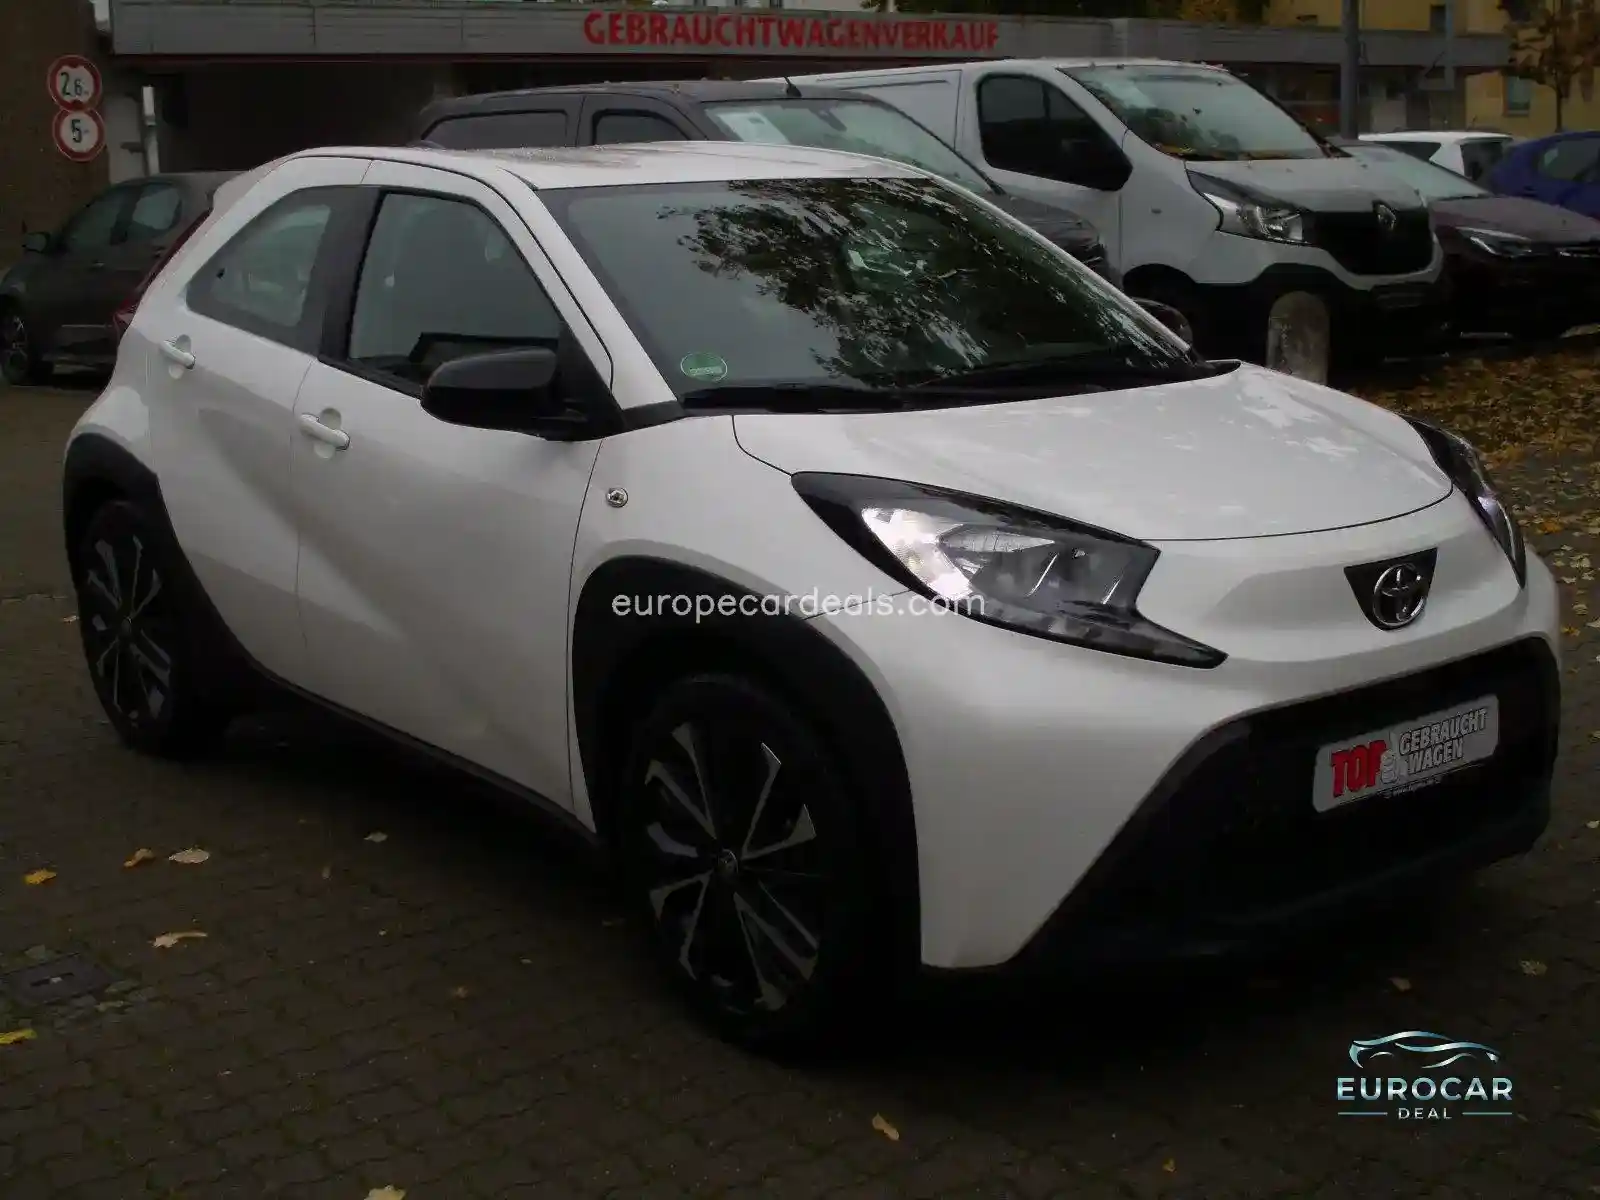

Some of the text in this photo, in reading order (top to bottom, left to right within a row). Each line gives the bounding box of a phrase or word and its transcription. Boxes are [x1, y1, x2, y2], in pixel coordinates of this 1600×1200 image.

[584, 11, 999, 50] GEBRAUCHTWAGENVERKAUF
[1400, 708, 1487, 755] GEBRAUCHT
[1331, 740, 1387, 798] TOP
[1407, 738, 1464, 775] WAGEN
